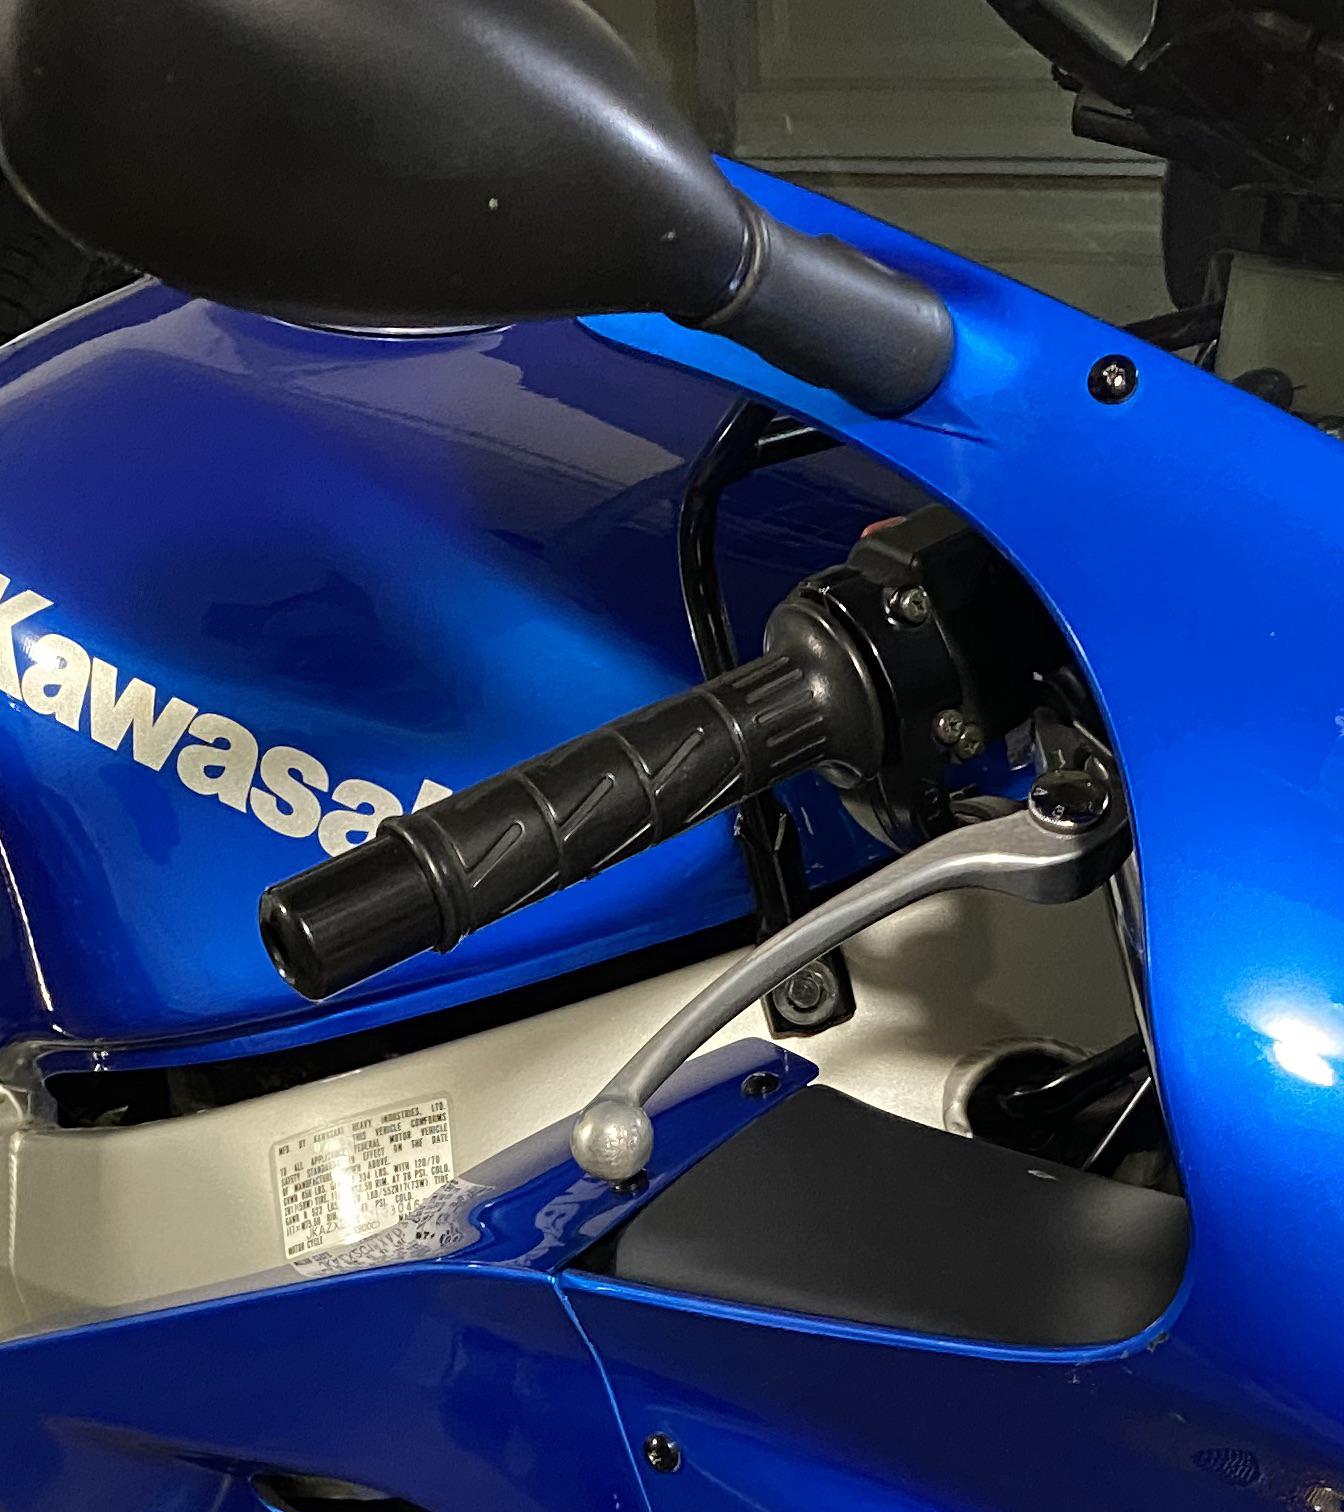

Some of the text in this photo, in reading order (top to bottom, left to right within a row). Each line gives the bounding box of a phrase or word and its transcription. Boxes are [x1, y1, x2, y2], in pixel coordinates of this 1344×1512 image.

[352, 1119, 371, 1131] HEAVY
[352, 1112, 446, 1142] THIS VEHICLE CONFORMS
[294, 1162, 303, 1171] ALL
[354, 1139, 380, 1152] FEDERAL
[389, 1131, 411, 1143] MOTOR
[421, 1123, 447, 1136] VEHICLE
[281, 1173, 300, 1185] SAFETY
[363, 1148, 384, 1160] EFFECT
[393, 1143, 402, 1152] ON
[411, 1138, 422, 1148] THE
[432, 1133, 447, 1144] DATE
[394, 1162, 409, 1172] WITH
[392, 1174, 399, 1183] AT
